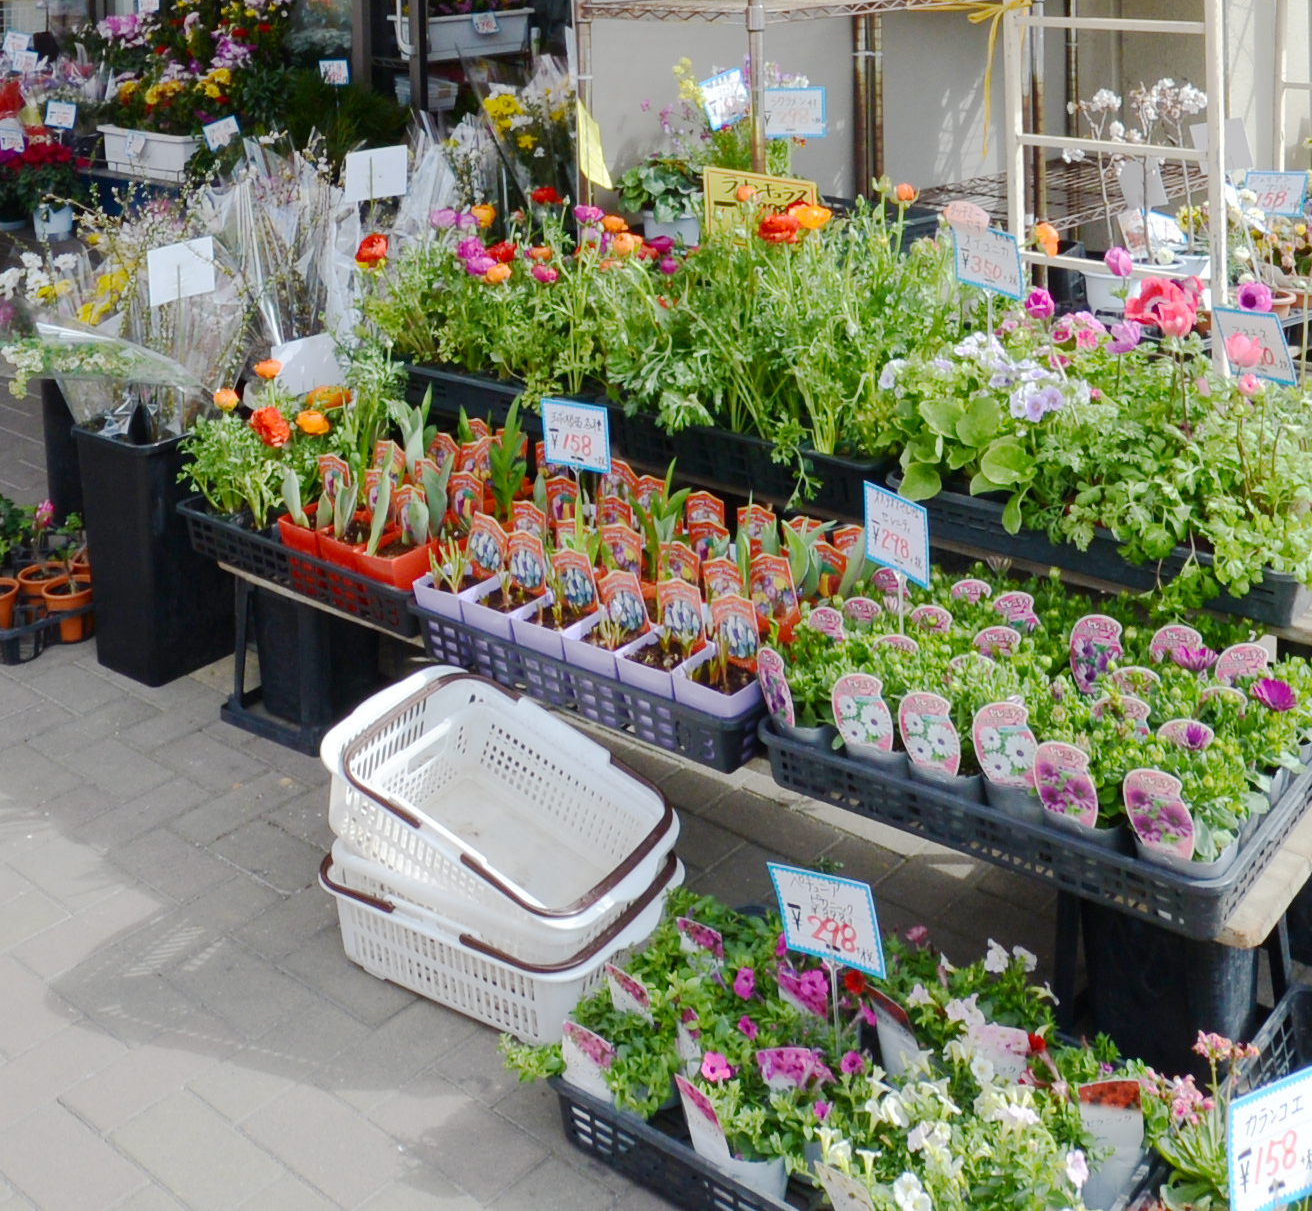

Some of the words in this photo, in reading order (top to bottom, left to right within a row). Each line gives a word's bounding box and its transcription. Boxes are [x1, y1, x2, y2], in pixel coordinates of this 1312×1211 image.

[790, 876, 839, 898] ペチュニア
[1245, 1095, 1304, 1138] カランコエ
